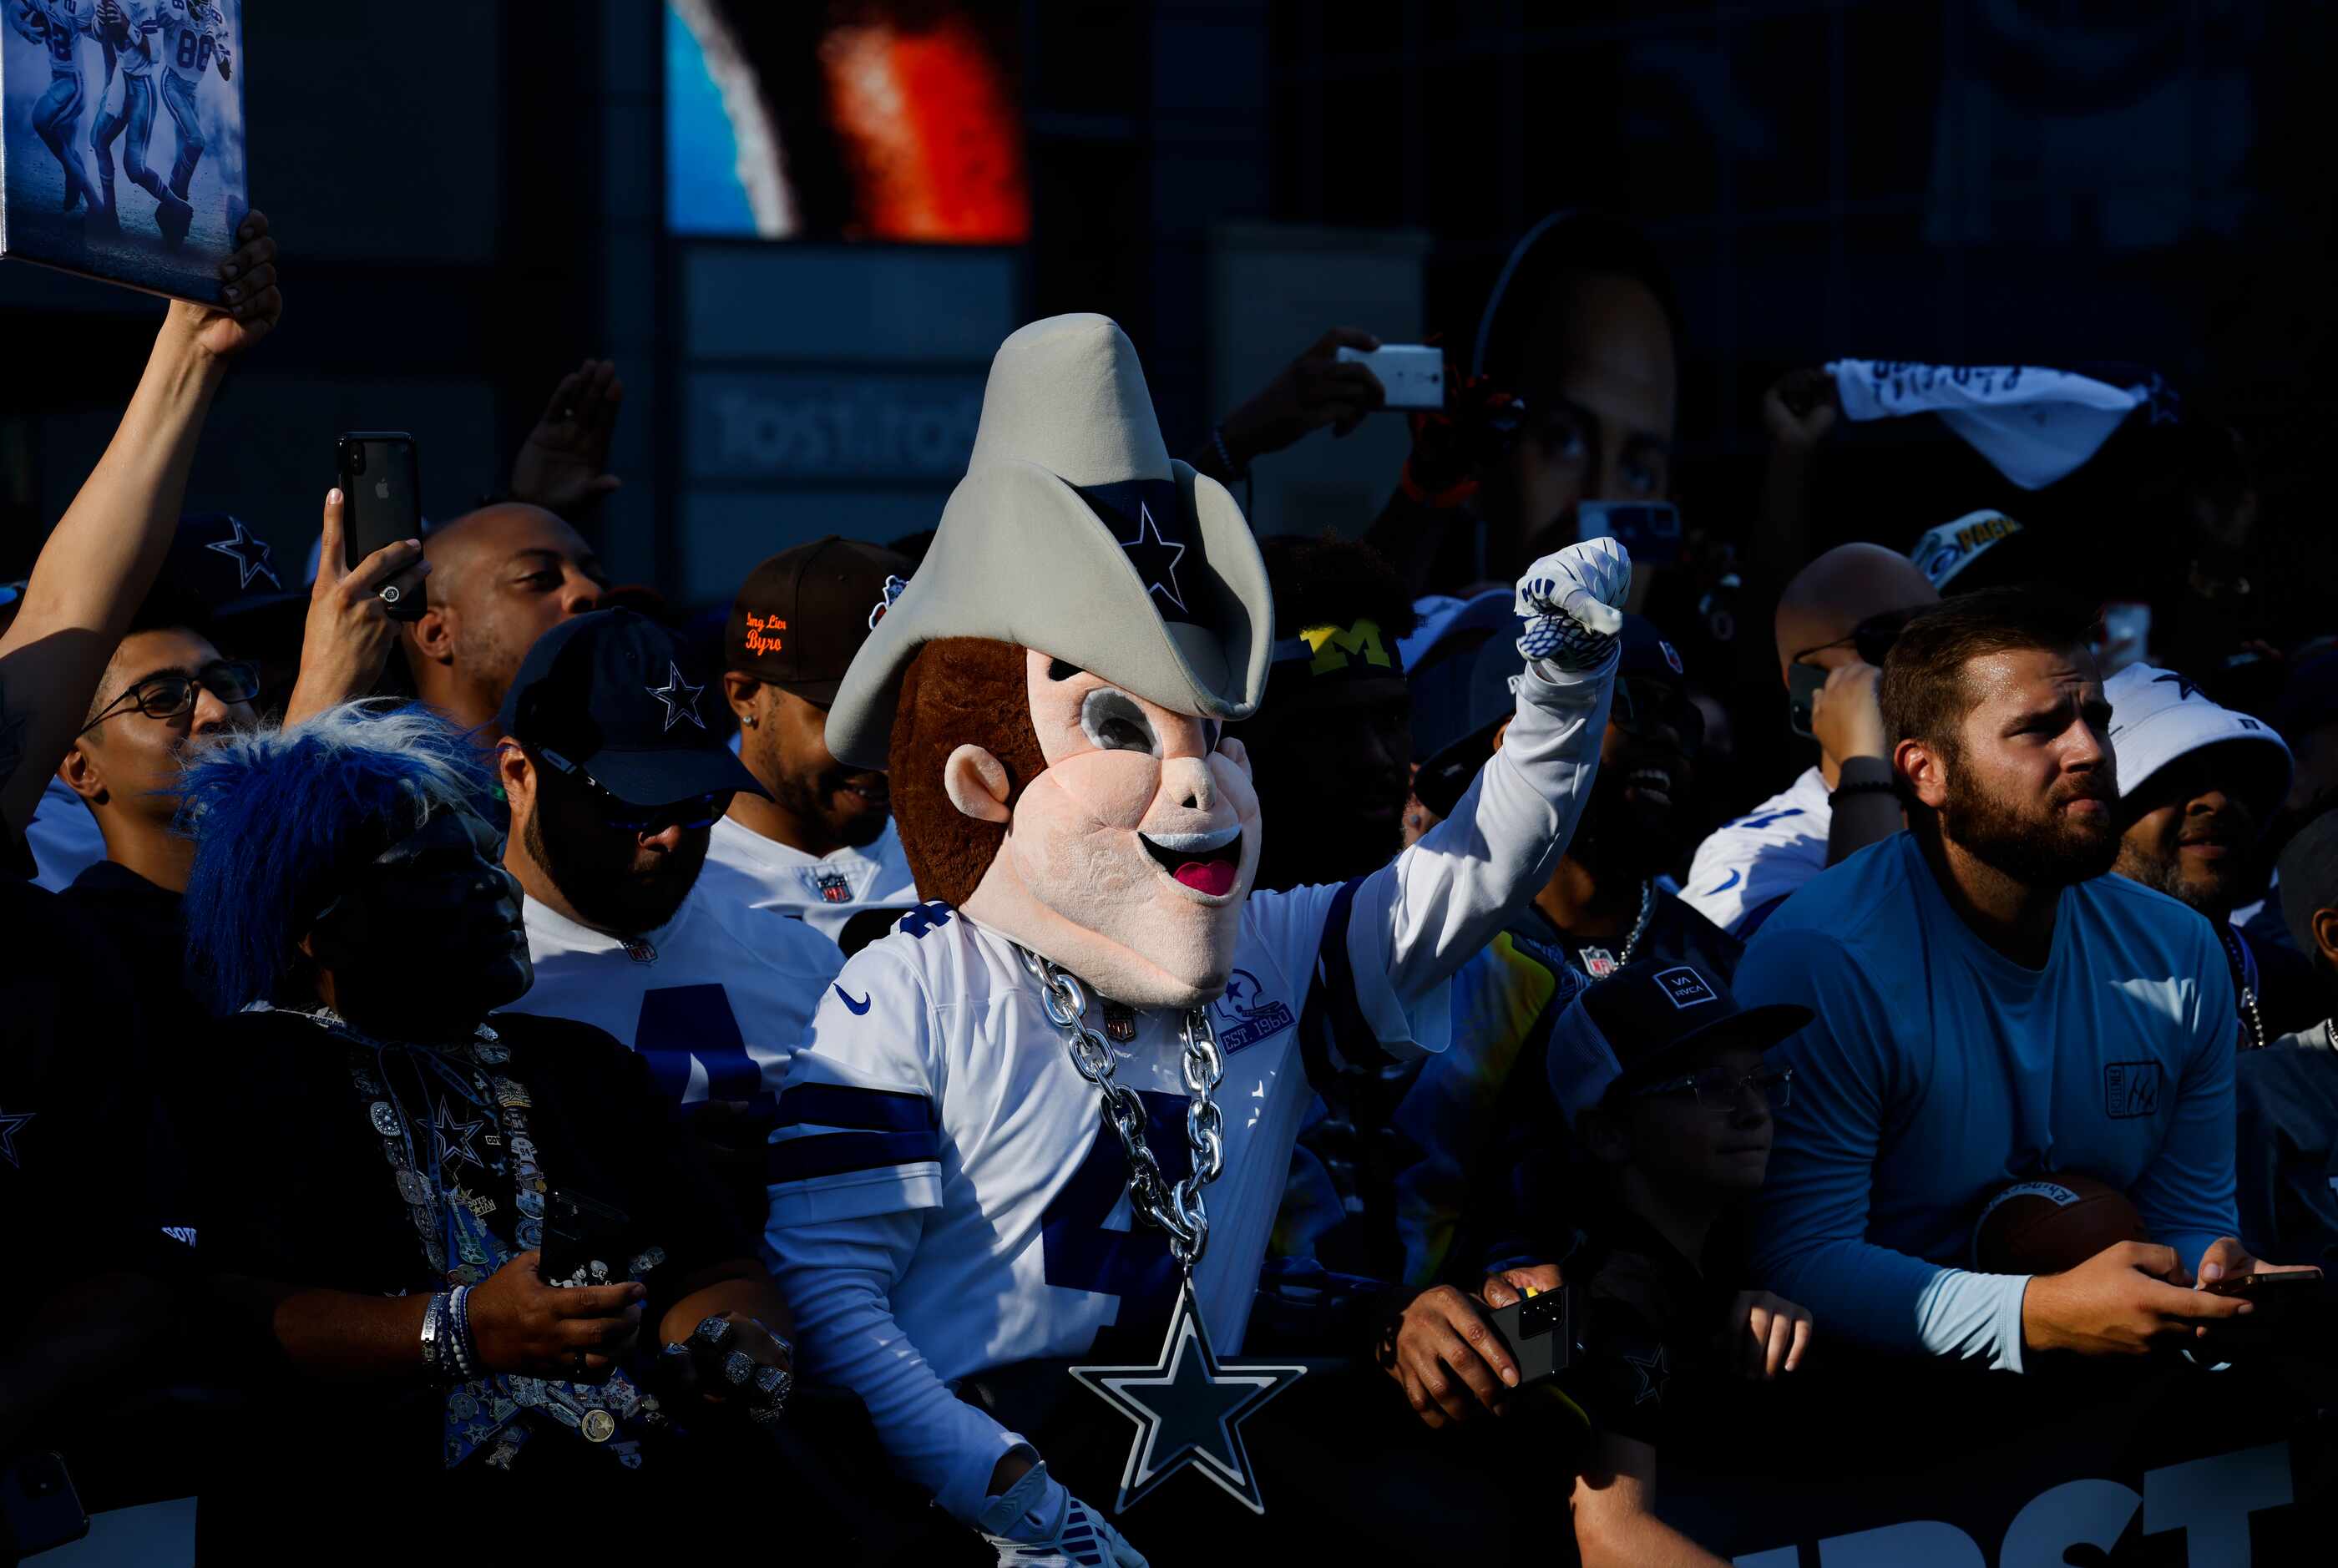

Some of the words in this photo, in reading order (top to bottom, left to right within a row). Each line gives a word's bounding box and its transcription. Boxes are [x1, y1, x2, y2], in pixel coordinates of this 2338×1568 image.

[176, 28, 215, 72] 88
[1299, 618, 1390, 677] M
[821, 885, 851, 903] NFL
[1107, 1019, 1134, 1037] NFL
[1223, 1028, 1252, 1050] EST.
[1254, 1009, 1290, 1036] 1960
